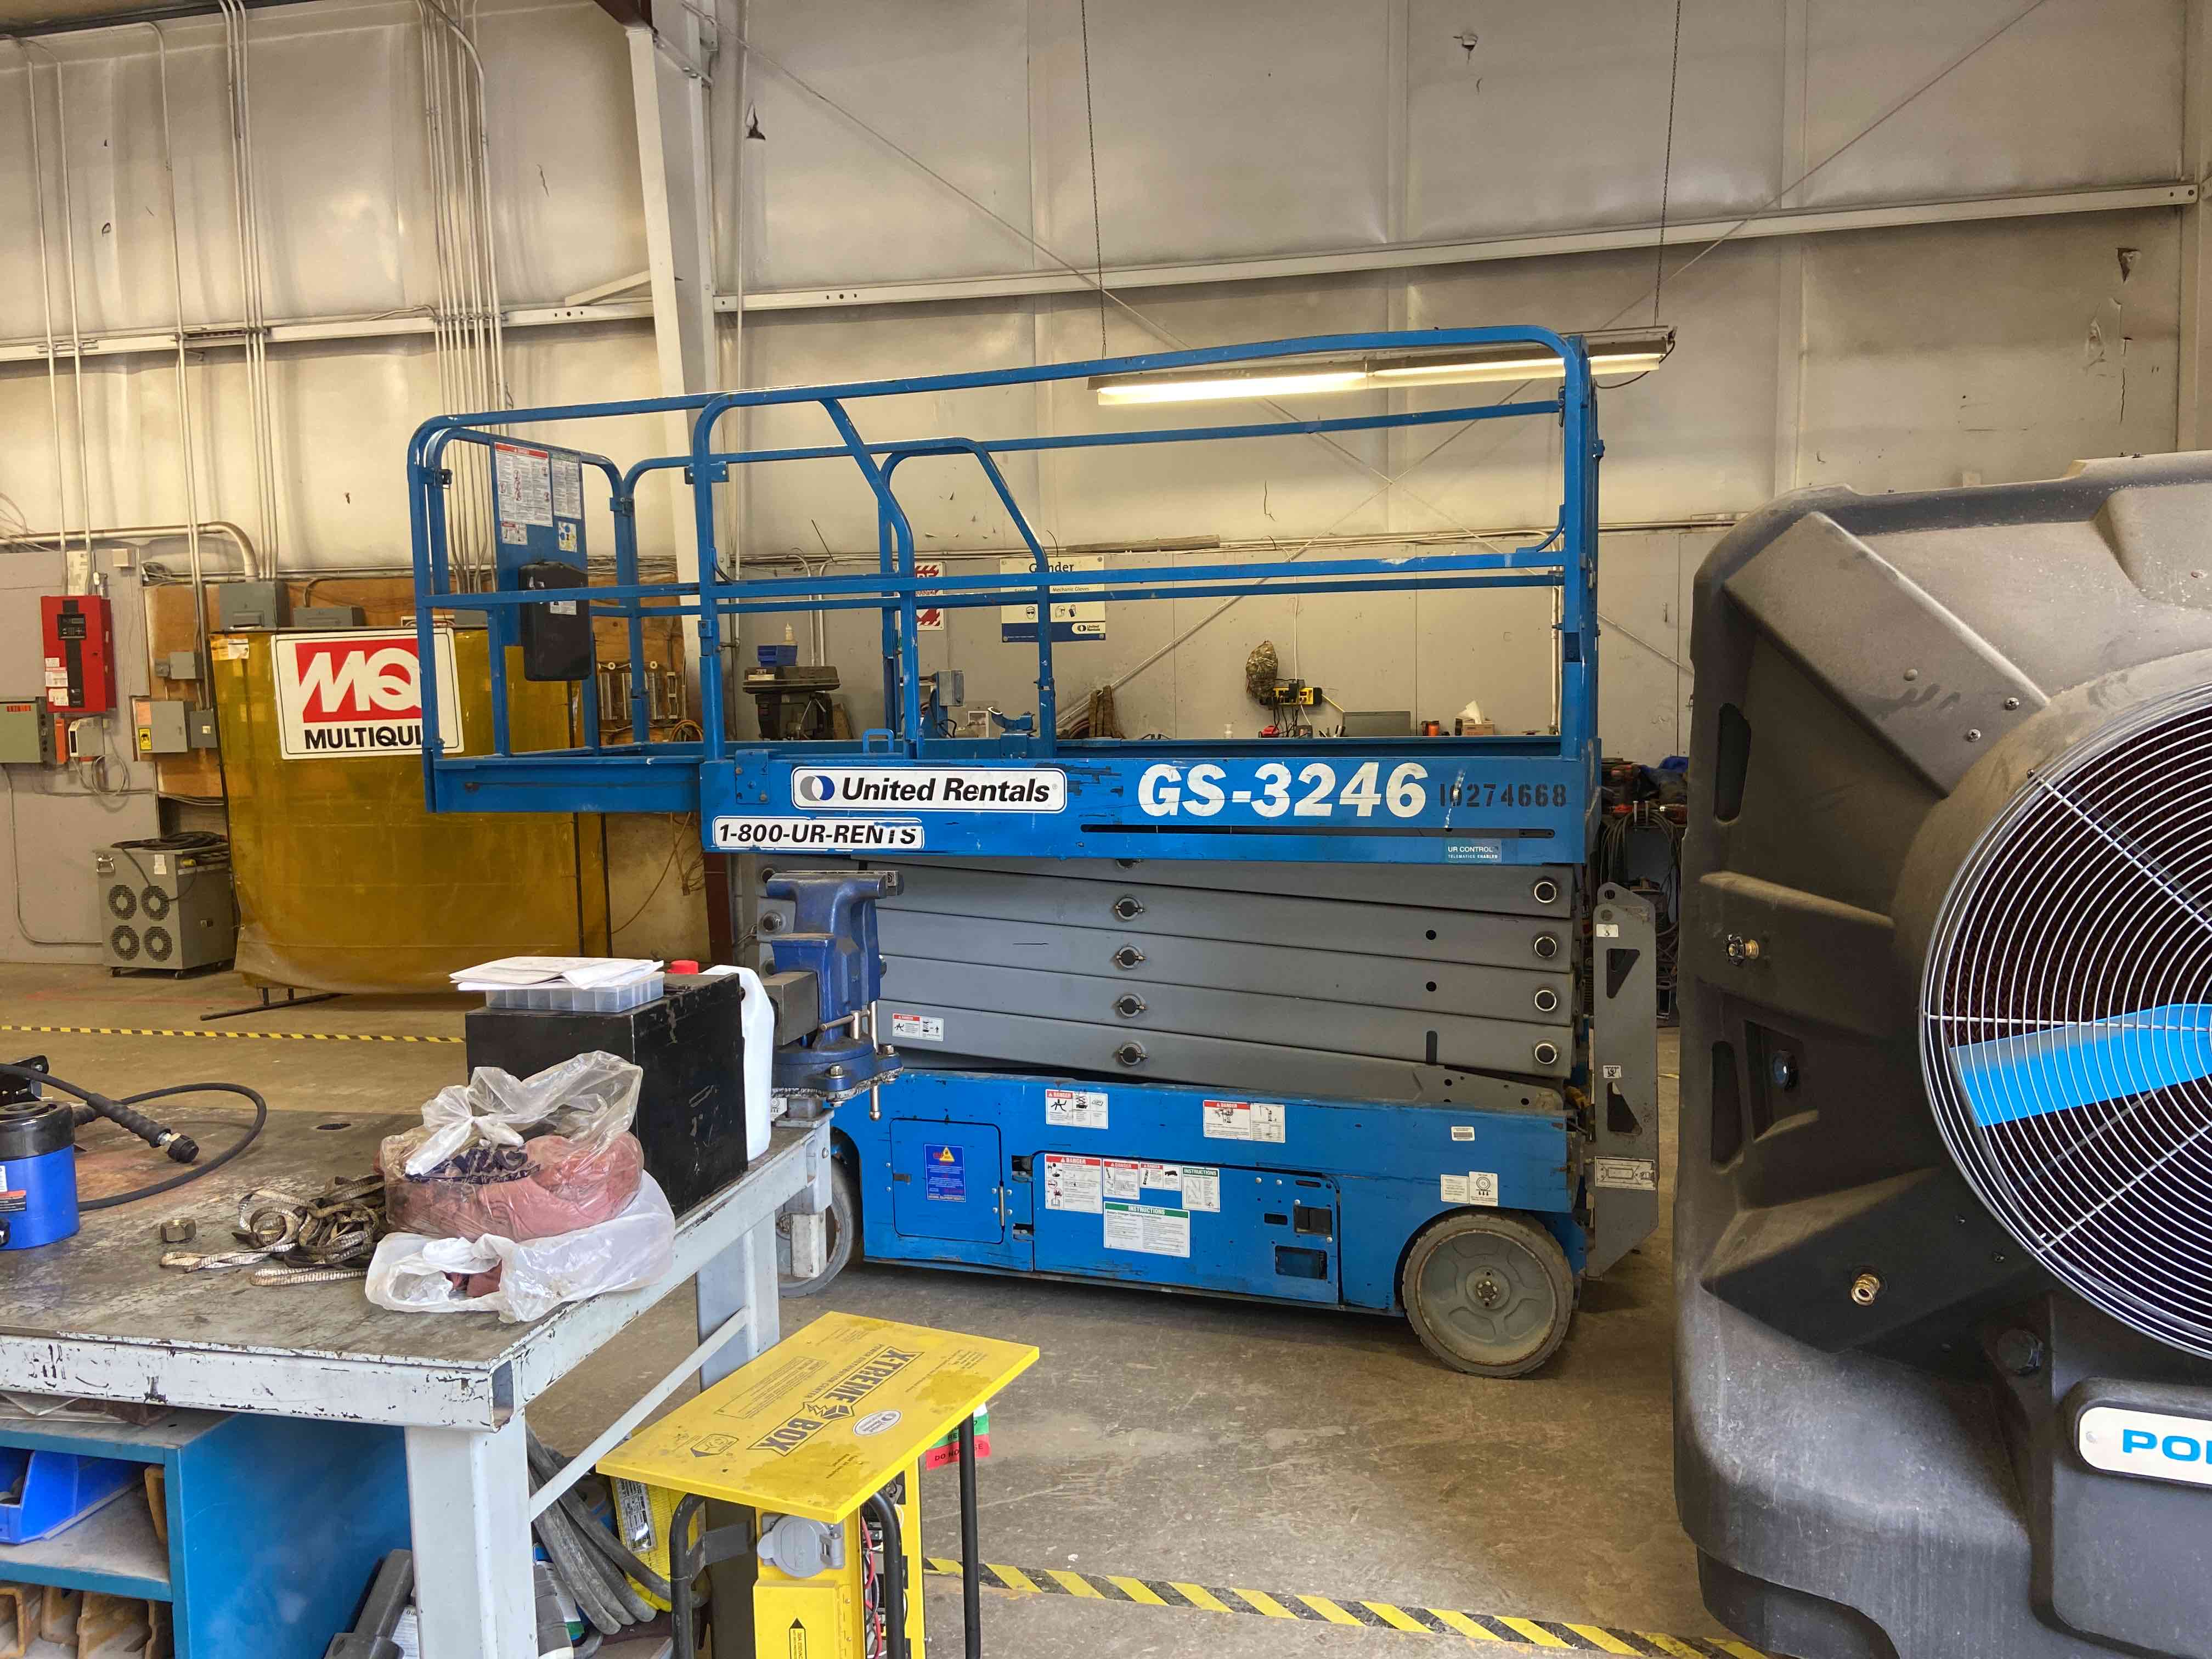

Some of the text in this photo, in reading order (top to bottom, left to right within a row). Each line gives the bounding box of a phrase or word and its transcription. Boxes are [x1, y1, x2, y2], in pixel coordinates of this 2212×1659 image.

[1029, 562, 1074, 573] Gnder
[304, 725, 422, 749] MULTIQUI
[842, 777, 1049, 802] United Rentals
[1138, 761, 1428, 817] GS-3246
[1440, 782, 1567, 808] 10274668
[1184, 1168, 1217, 1176] INSTRUCTIONS
[1128, 1205, 1165, 1215] INSTRUCTIONS
[825, 1349, 916, 1403] X-TREME
[756, 1418, 825, 1452] BOX
[2122, 1428, 2212, 1465] PO
